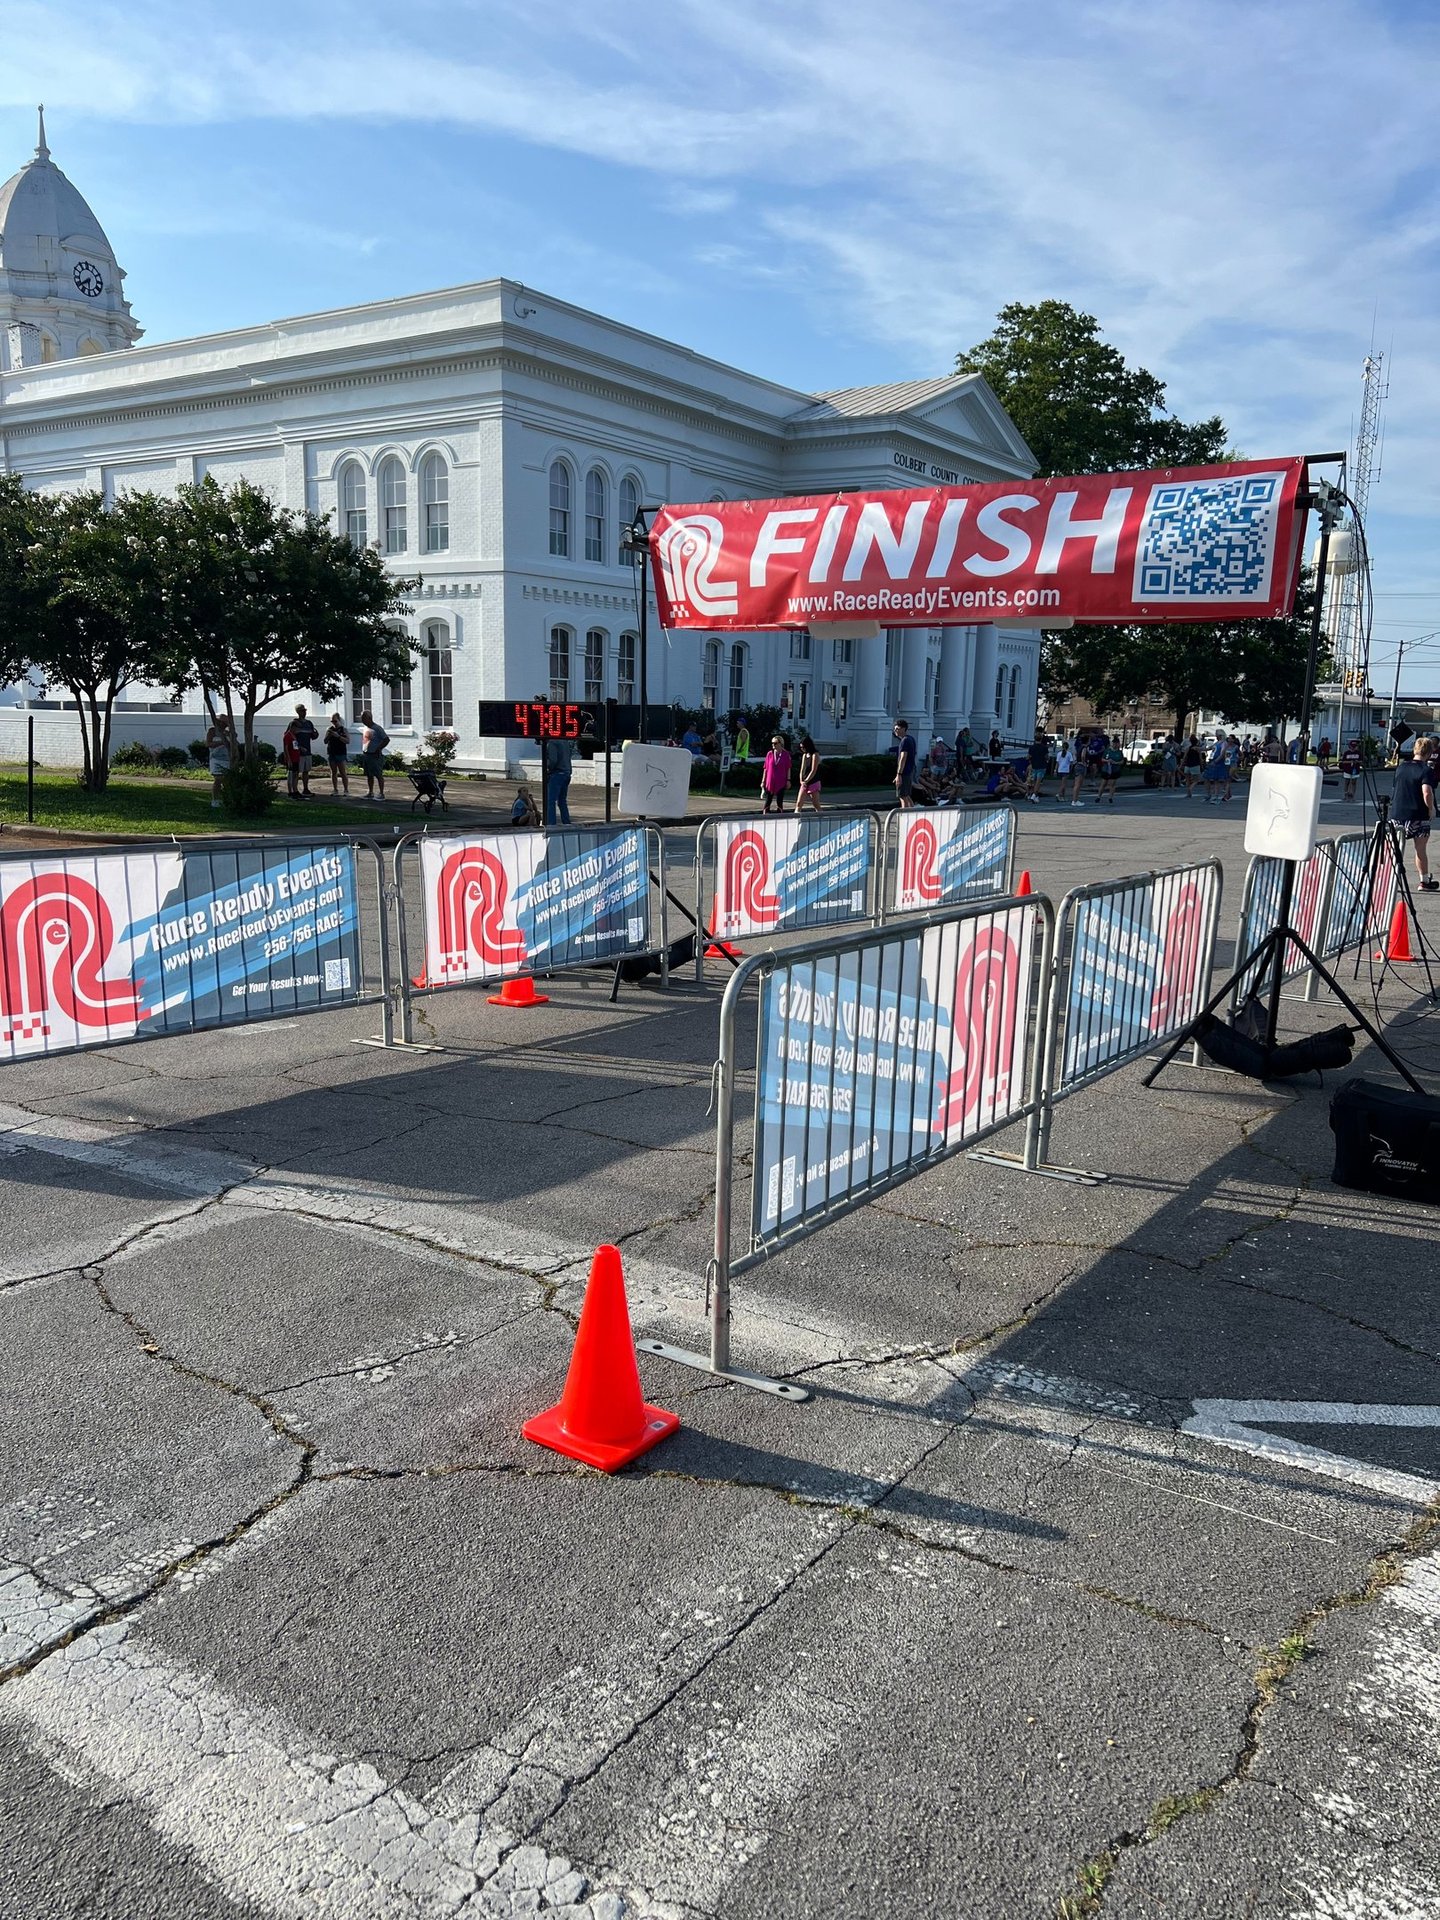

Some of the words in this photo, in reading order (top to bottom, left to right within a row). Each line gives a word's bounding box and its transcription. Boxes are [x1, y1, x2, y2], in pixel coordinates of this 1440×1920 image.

[894, 452, 926, 474] COLBERT
[930, 465, 959, 485] COUNTY
[749, 486, 1134, 588] FINISH
[787, 586, 1060, 614] www.RaceReadyEvents.com
[515, 704, 578, 737] 47:05
[528, 877, 561, 908] Race
[562, 856, 602, 890] Ready
[604, 835, 638, 869] Events
[785, 855, 807, 877] Race
[808, 838, 835, 866] Ready
[836, 823, 864, 849] Events
[149, 910, 207, 952] Race
[209, 882, 274, 928] Ready
[276, 855, 342, 900] Events
[536, 859, 640, 924] www.RaceReadyEvents.com
[592, 879, 640, 916] 256-756-RACE
[163, 885, 343, 972] www.RaceReadyEvents.com
[263, 909, 345, 958] 256-756-RACE
[232, 984, 248, 996] Get
[249, 981, 268, 994] Your
[270, 976, 302, 991] Results
[302, 973, 324, 986] Now:
